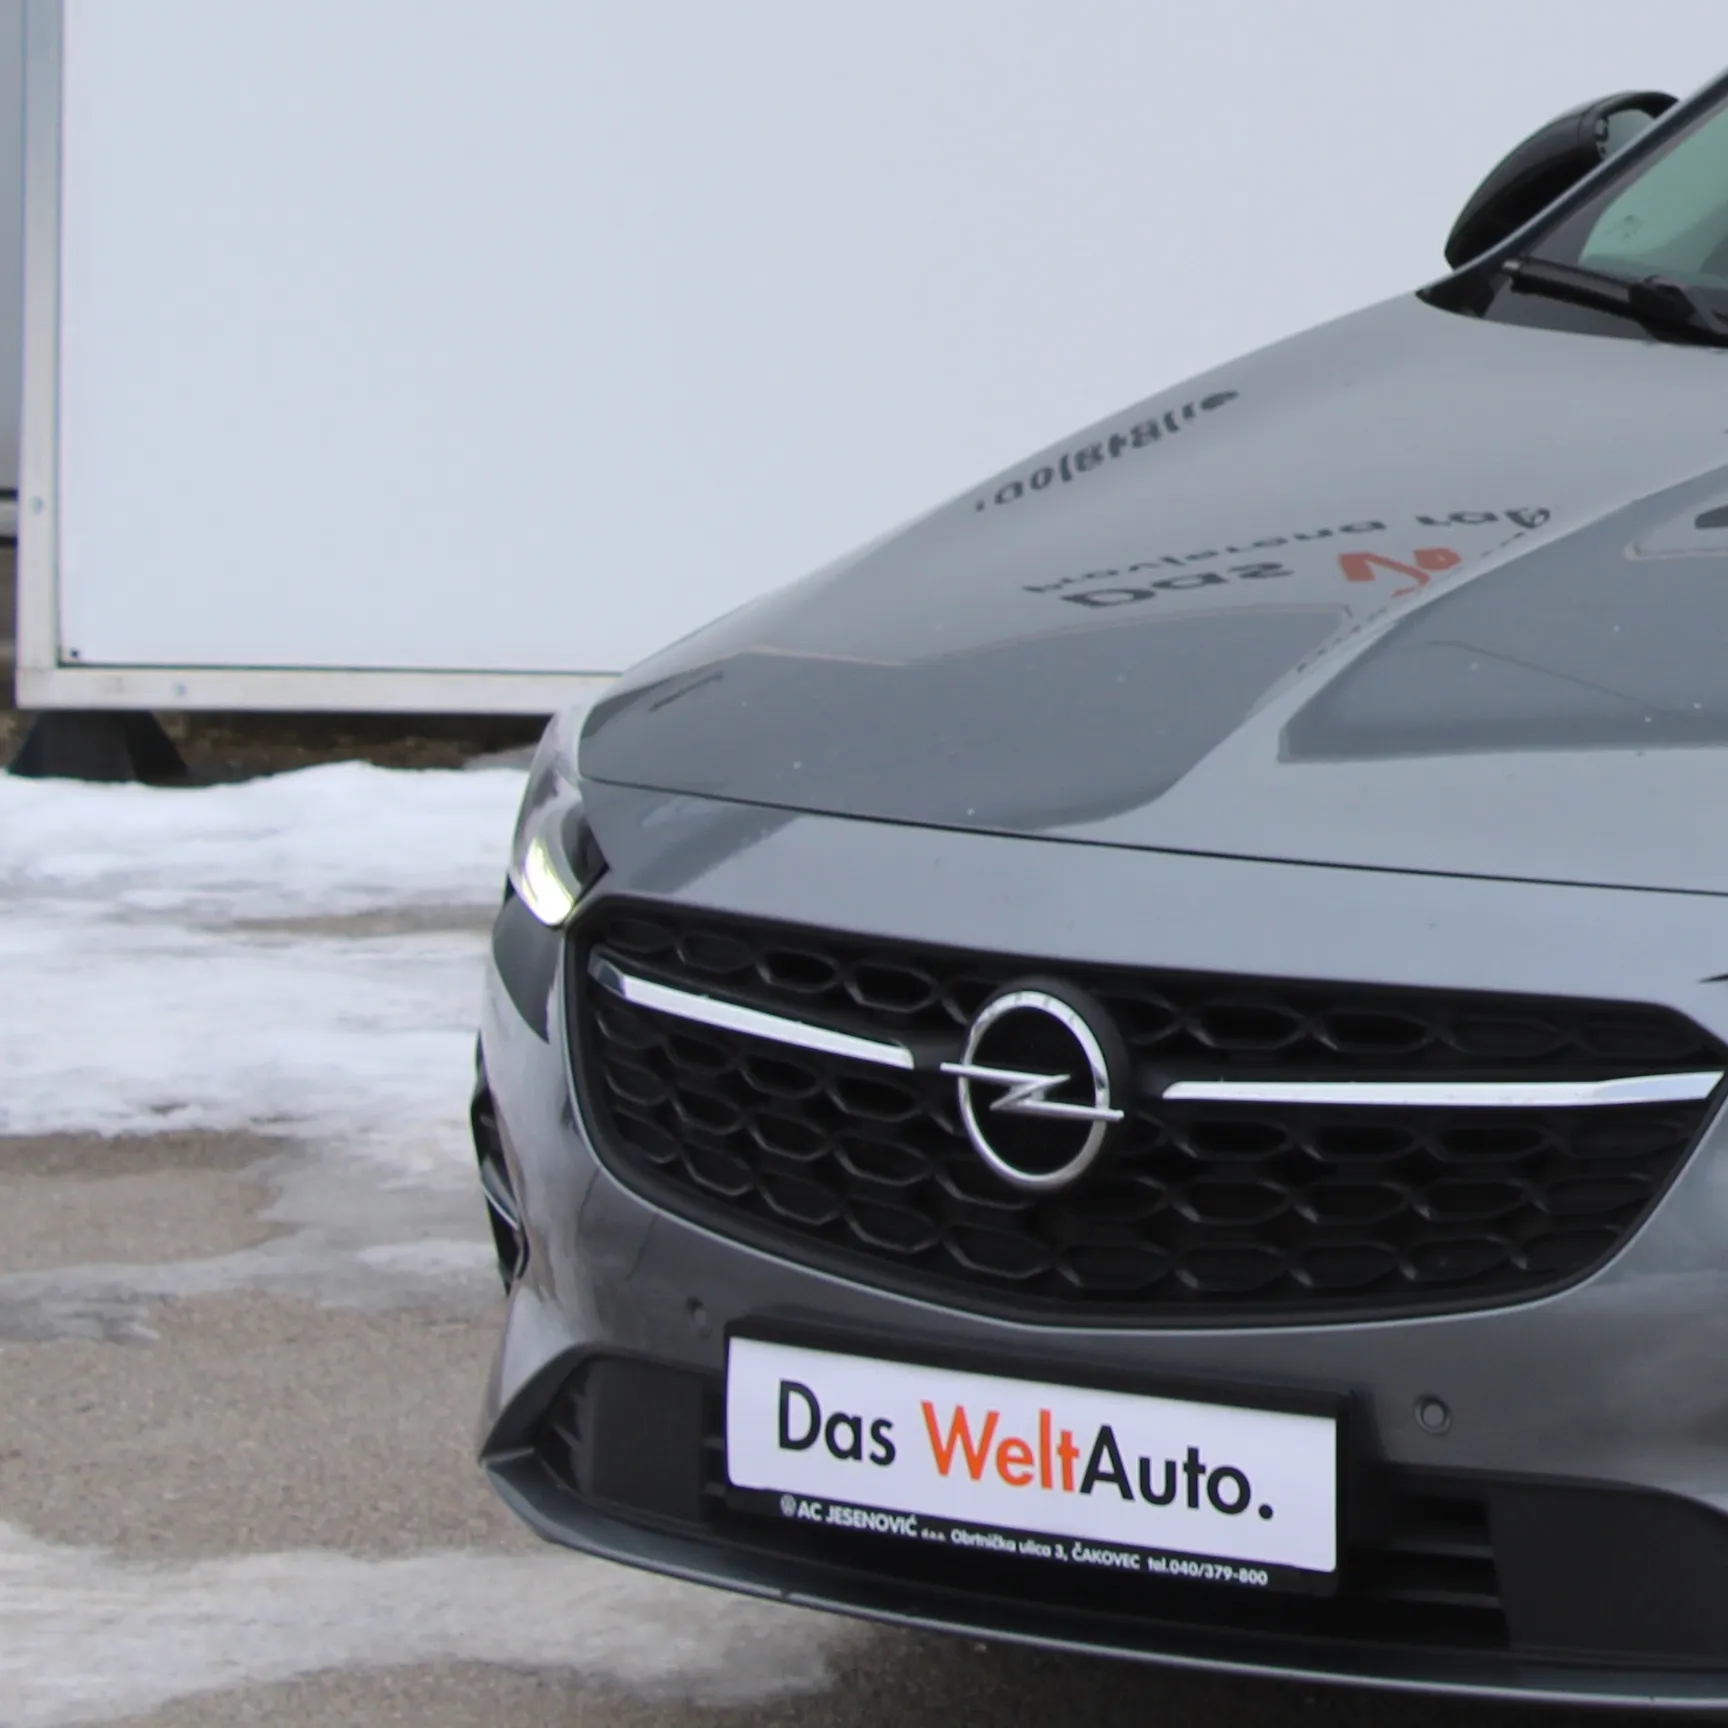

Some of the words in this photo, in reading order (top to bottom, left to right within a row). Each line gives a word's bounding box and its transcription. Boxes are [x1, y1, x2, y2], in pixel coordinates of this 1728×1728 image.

[778, 1379, 897, 1467] Das
[921, 1400, 1274, 1520] WeltAuto.
[797, 1500, 822, 1522] AC
[825, 1504, 918, 1538] JESENOVIĆ
[1071, 1541, 1141, 1570] ČAKOVEC
